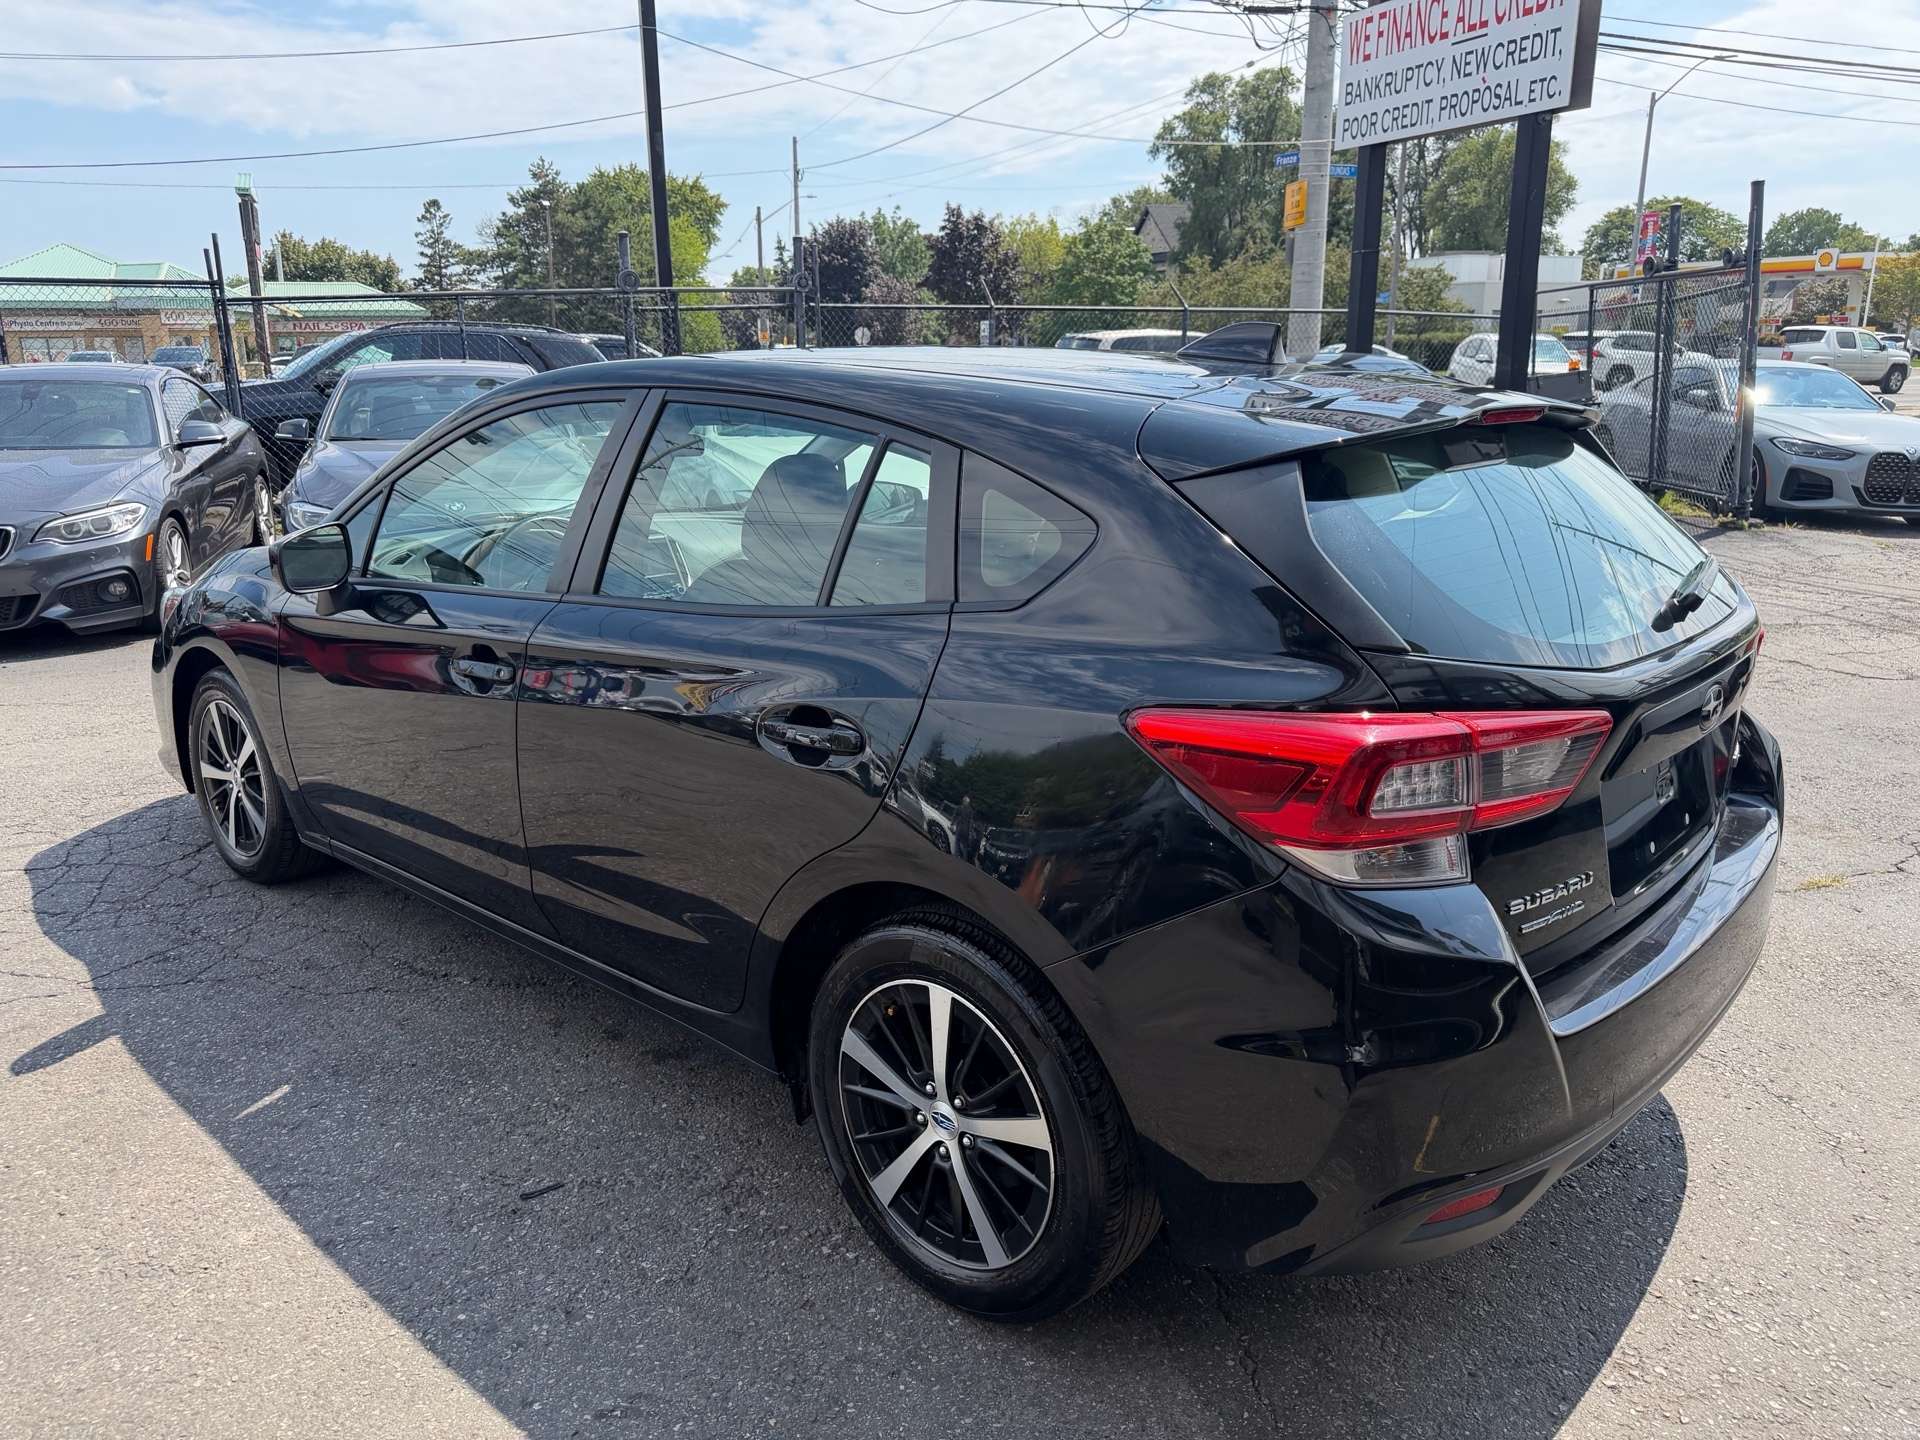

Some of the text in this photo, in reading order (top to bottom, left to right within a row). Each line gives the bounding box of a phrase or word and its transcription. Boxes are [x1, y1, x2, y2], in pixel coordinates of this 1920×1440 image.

[1348, 15, 1373, 66] WE
[1375, 0, 1449, 59] FINANCE
[1453, 0, 1489, 37] ALL
[1344, 57, 1445, 107] BANKRUPTCY,
[1341, 112, 1379, 142] POOR
[1380, 98, 1434, 133] CREDIT,
[1507, 870, 1594, 916] SUBARU
